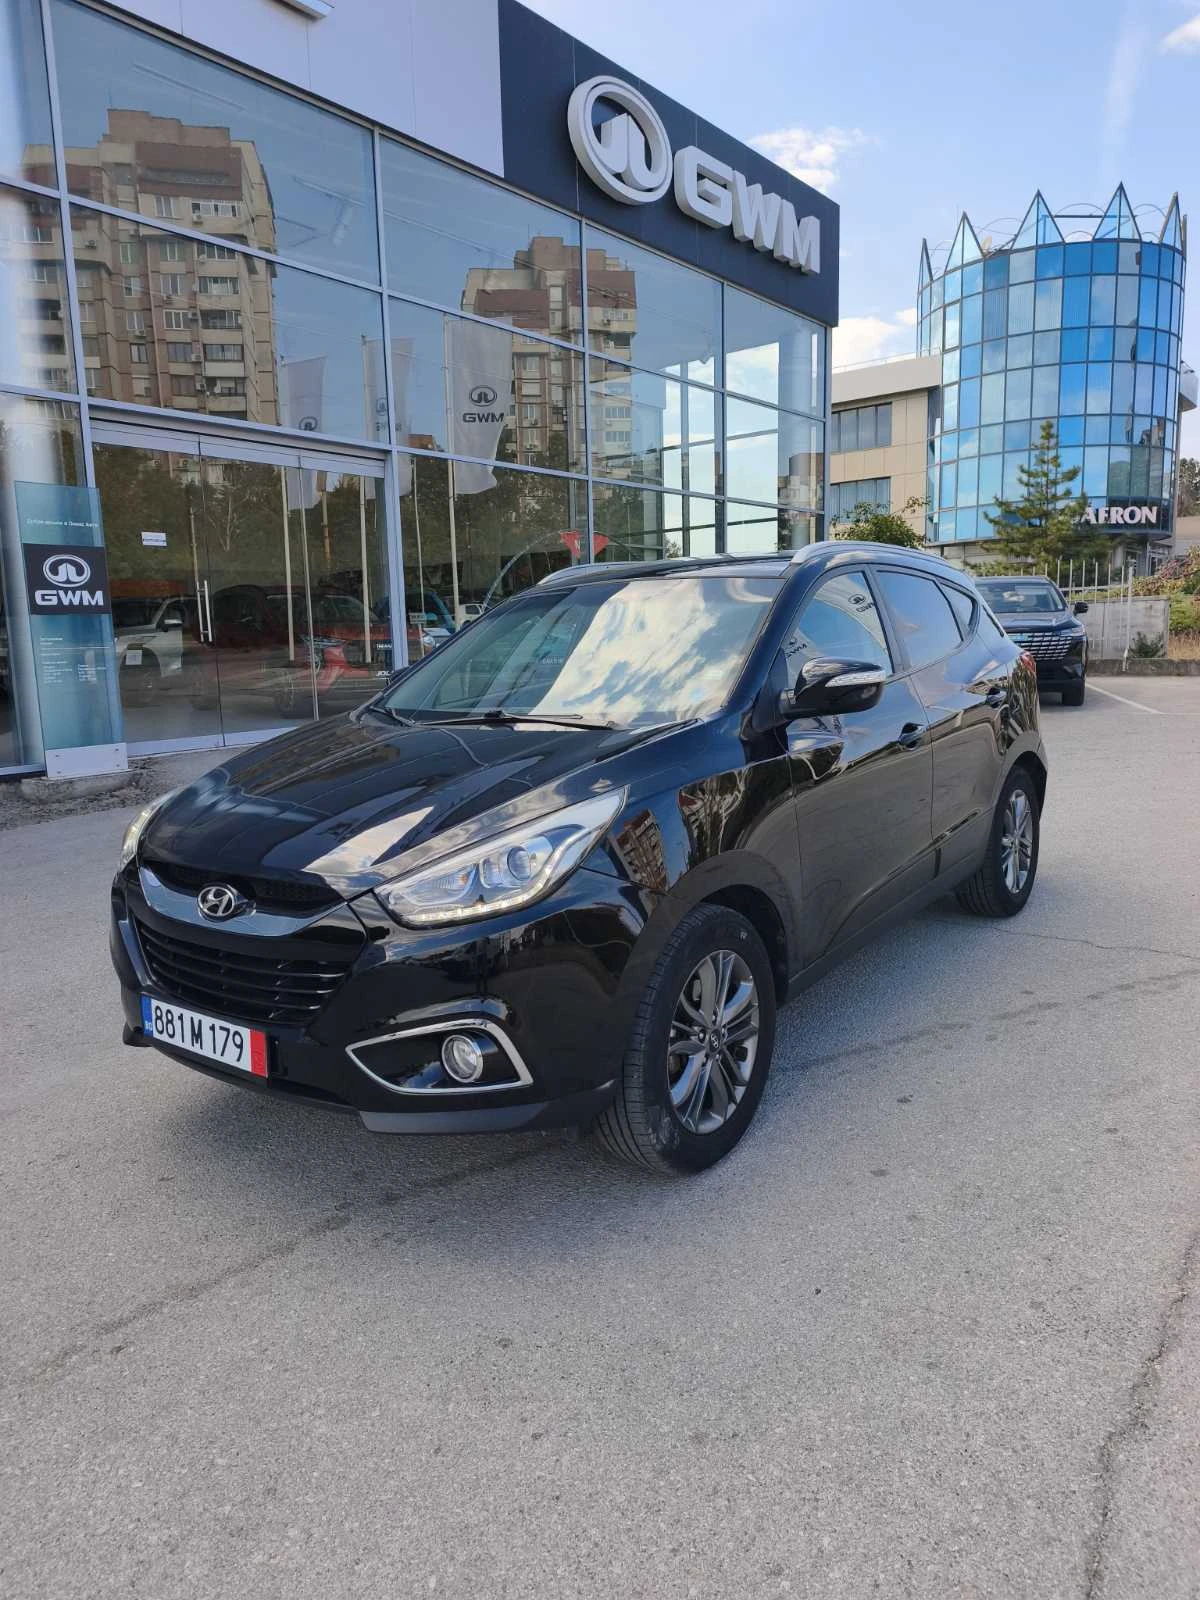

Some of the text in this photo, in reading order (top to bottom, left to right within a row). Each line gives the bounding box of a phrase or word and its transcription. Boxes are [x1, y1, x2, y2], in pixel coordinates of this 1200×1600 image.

[674, 145, 820, 274] GWM
[462, 412, 504, 423] GWM
[34, 589, 104, 606] GWM
[154, 1005, 244, 1062] 881 M 179
